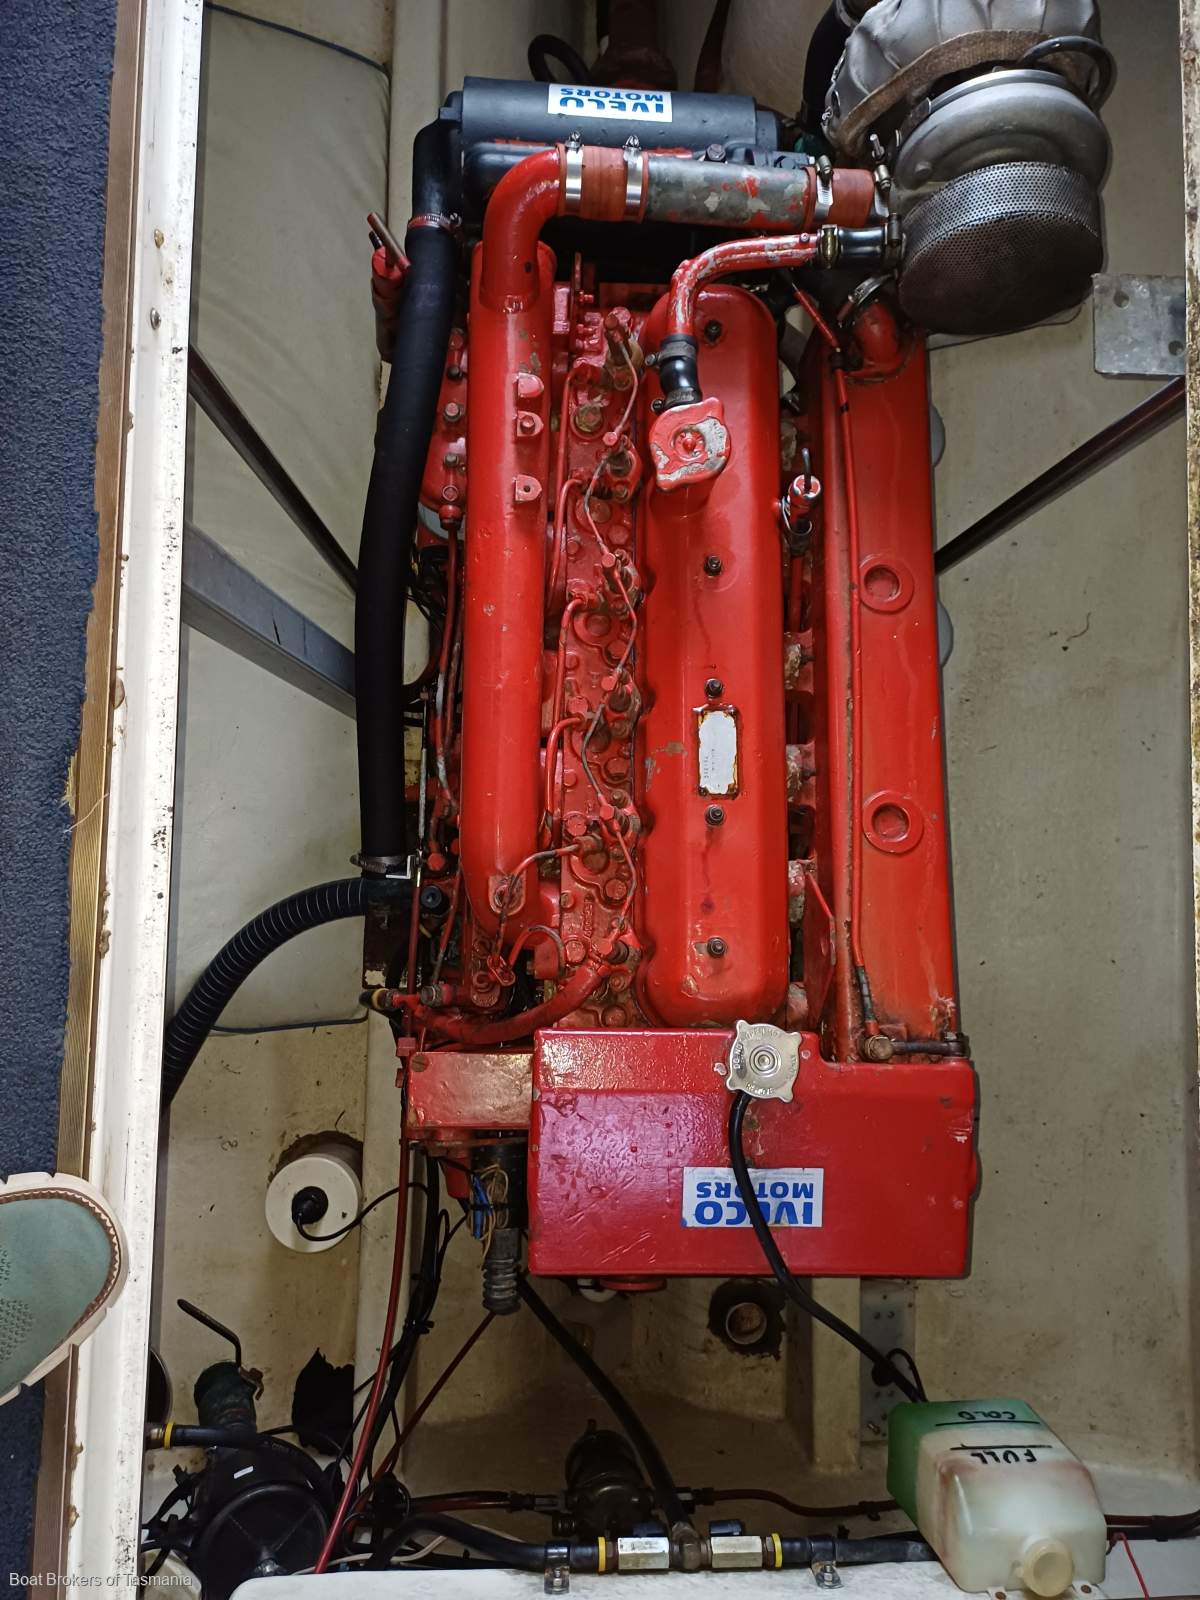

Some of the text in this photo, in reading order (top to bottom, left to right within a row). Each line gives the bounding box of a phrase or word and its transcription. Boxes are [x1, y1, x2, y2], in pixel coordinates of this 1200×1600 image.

[560, 87, 663, 102] MOTORS
[958, 1410, 1016, 1420] COLD
[970, 1448, 1037, 1465] FULL
